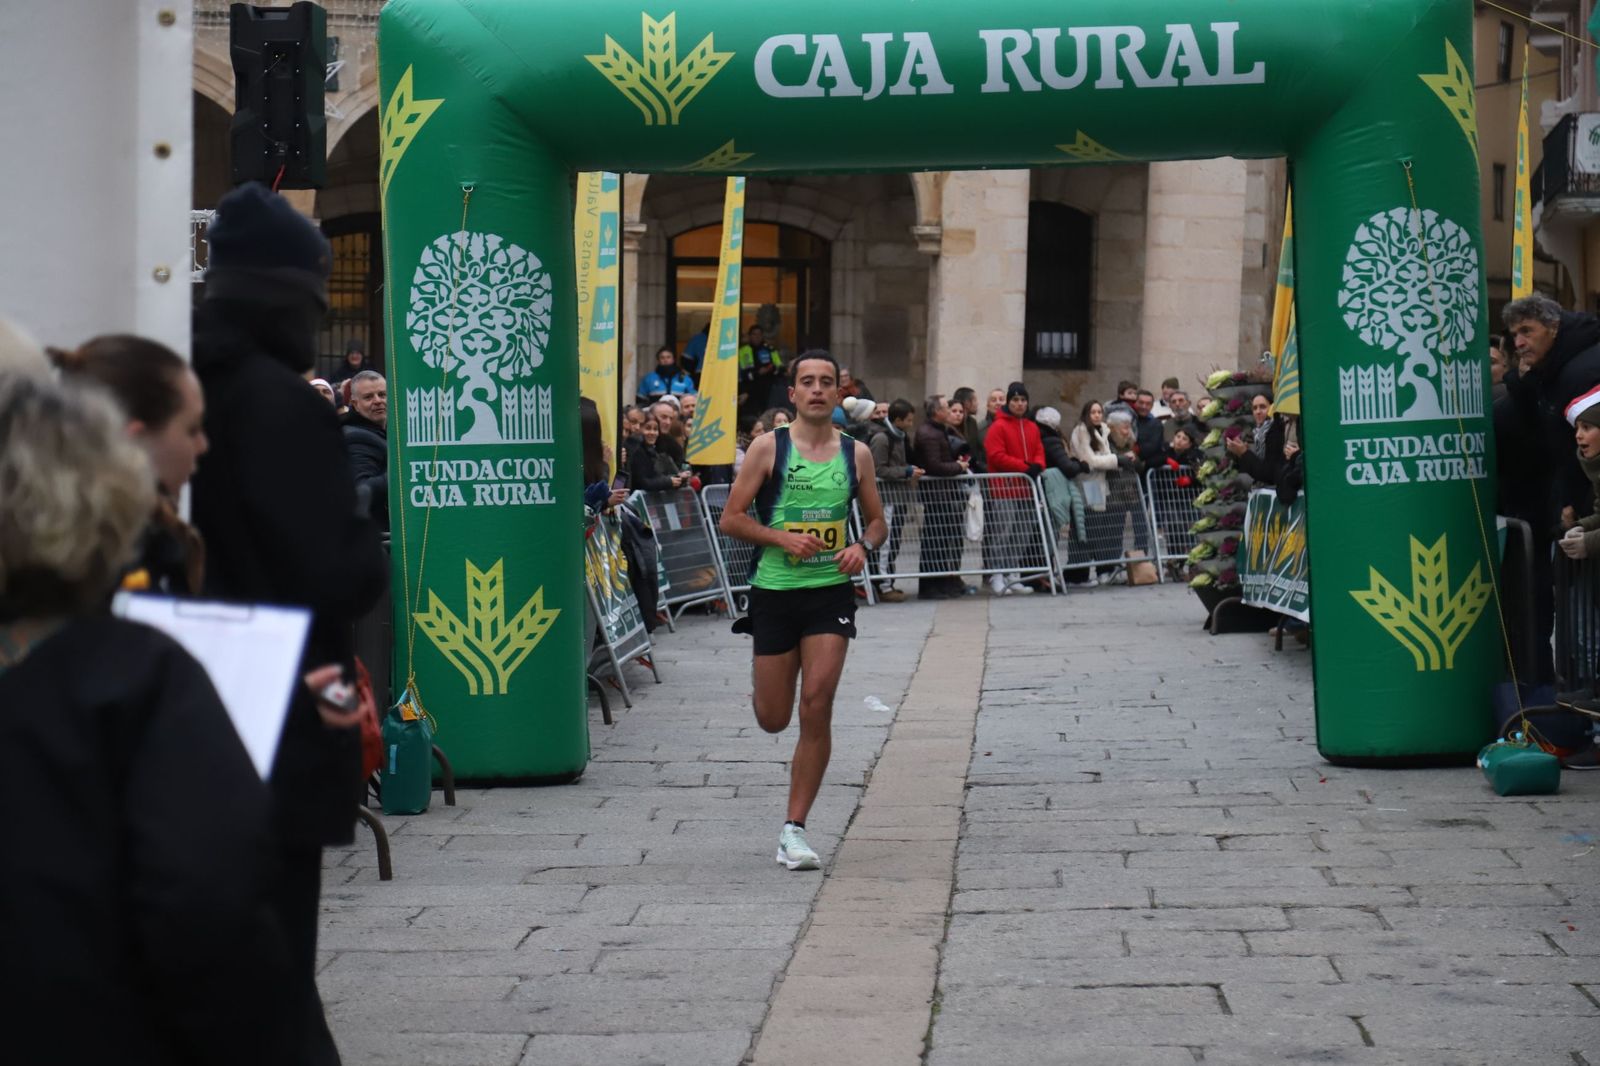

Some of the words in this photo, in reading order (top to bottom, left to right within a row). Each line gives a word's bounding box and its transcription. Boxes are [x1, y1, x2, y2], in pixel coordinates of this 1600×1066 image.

[754, 31, 954, 101] CAJA
[979, 22, 1266, 94] RURAL
[1344, 432, 1486, 460] FUNDACION
[409, 458, 555, 483] FUNDACION
[1346, 460, 1410, 486] CAJA
[1416, 457, 1488, 482] RURAL
[410, 485, 467, 509] CAJA
[473, 483, 556, 506] RURAL
